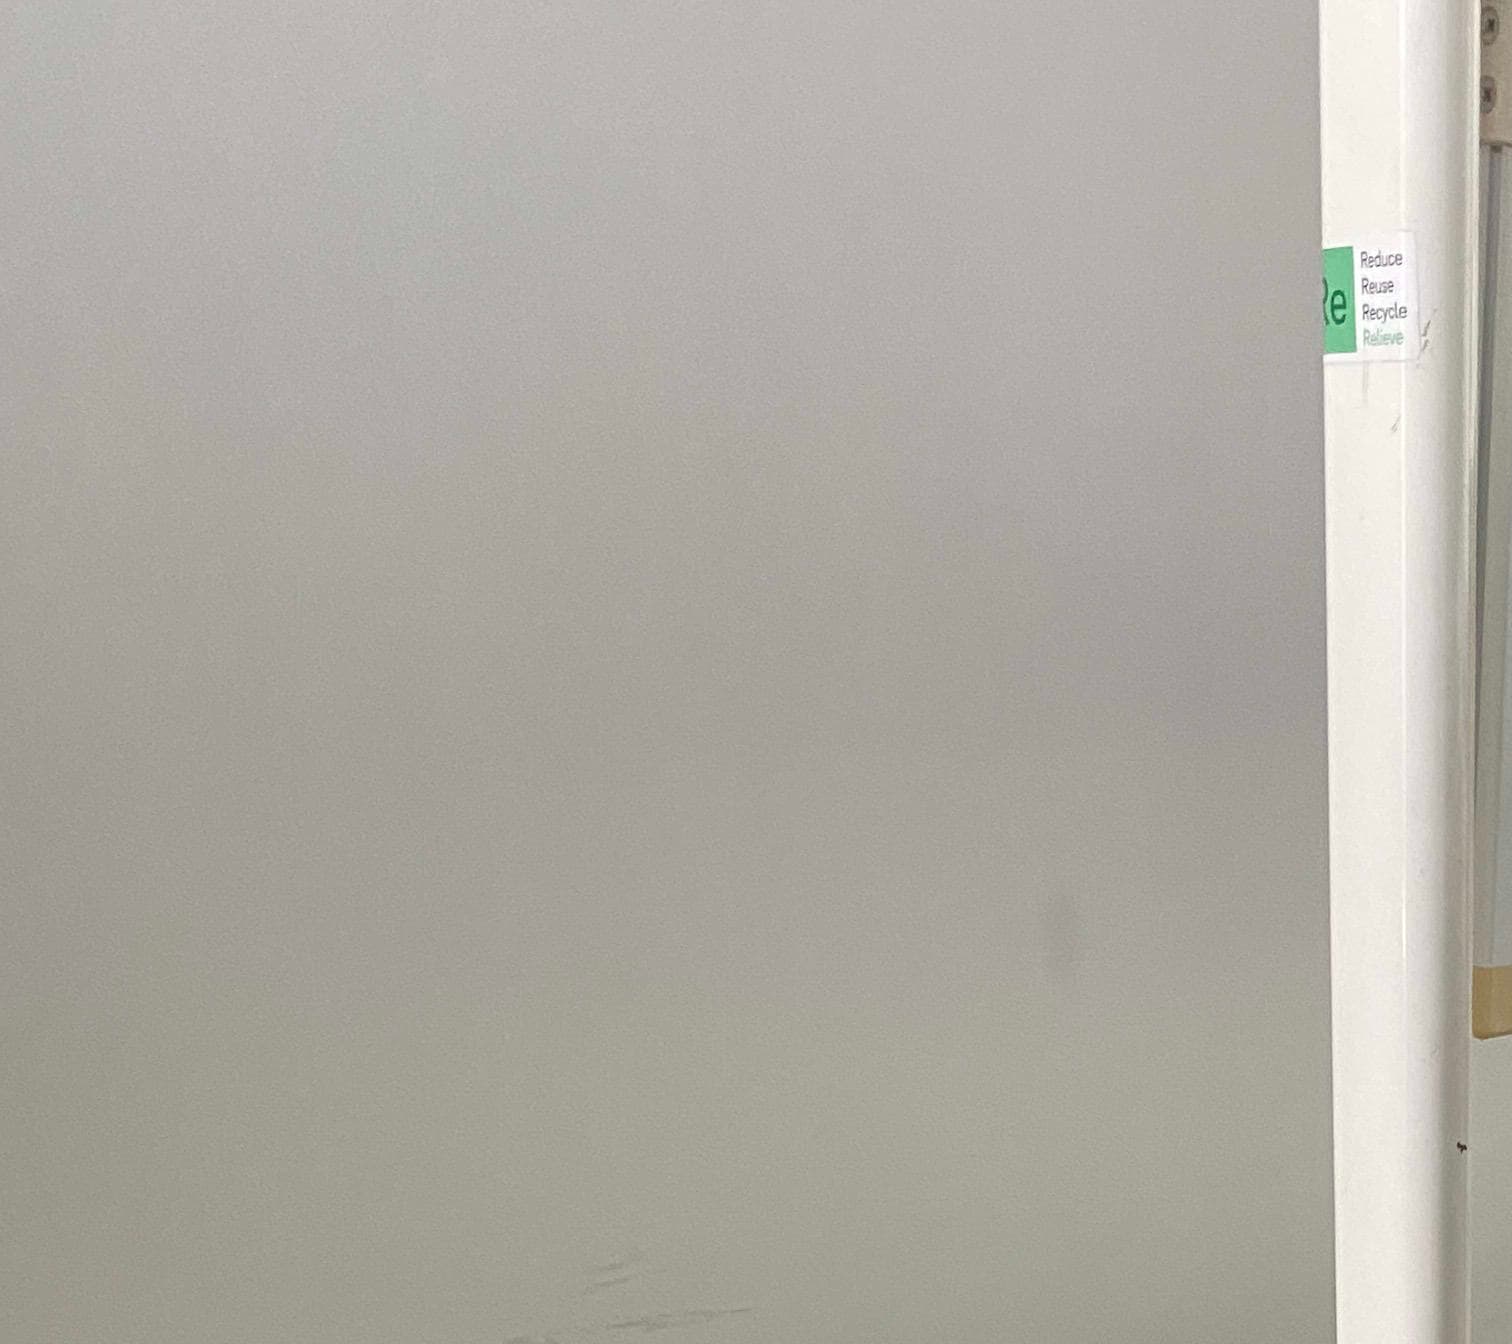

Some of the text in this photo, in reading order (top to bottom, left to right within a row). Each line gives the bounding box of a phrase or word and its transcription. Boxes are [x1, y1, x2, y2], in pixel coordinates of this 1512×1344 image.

[1360, 250, 1403, 268] Reduce
[1361, 277, 1395, 294] Reuse
[1362, 302, 1408, 323] Recycle
[1363, 328, 1404, 346] Relieve
